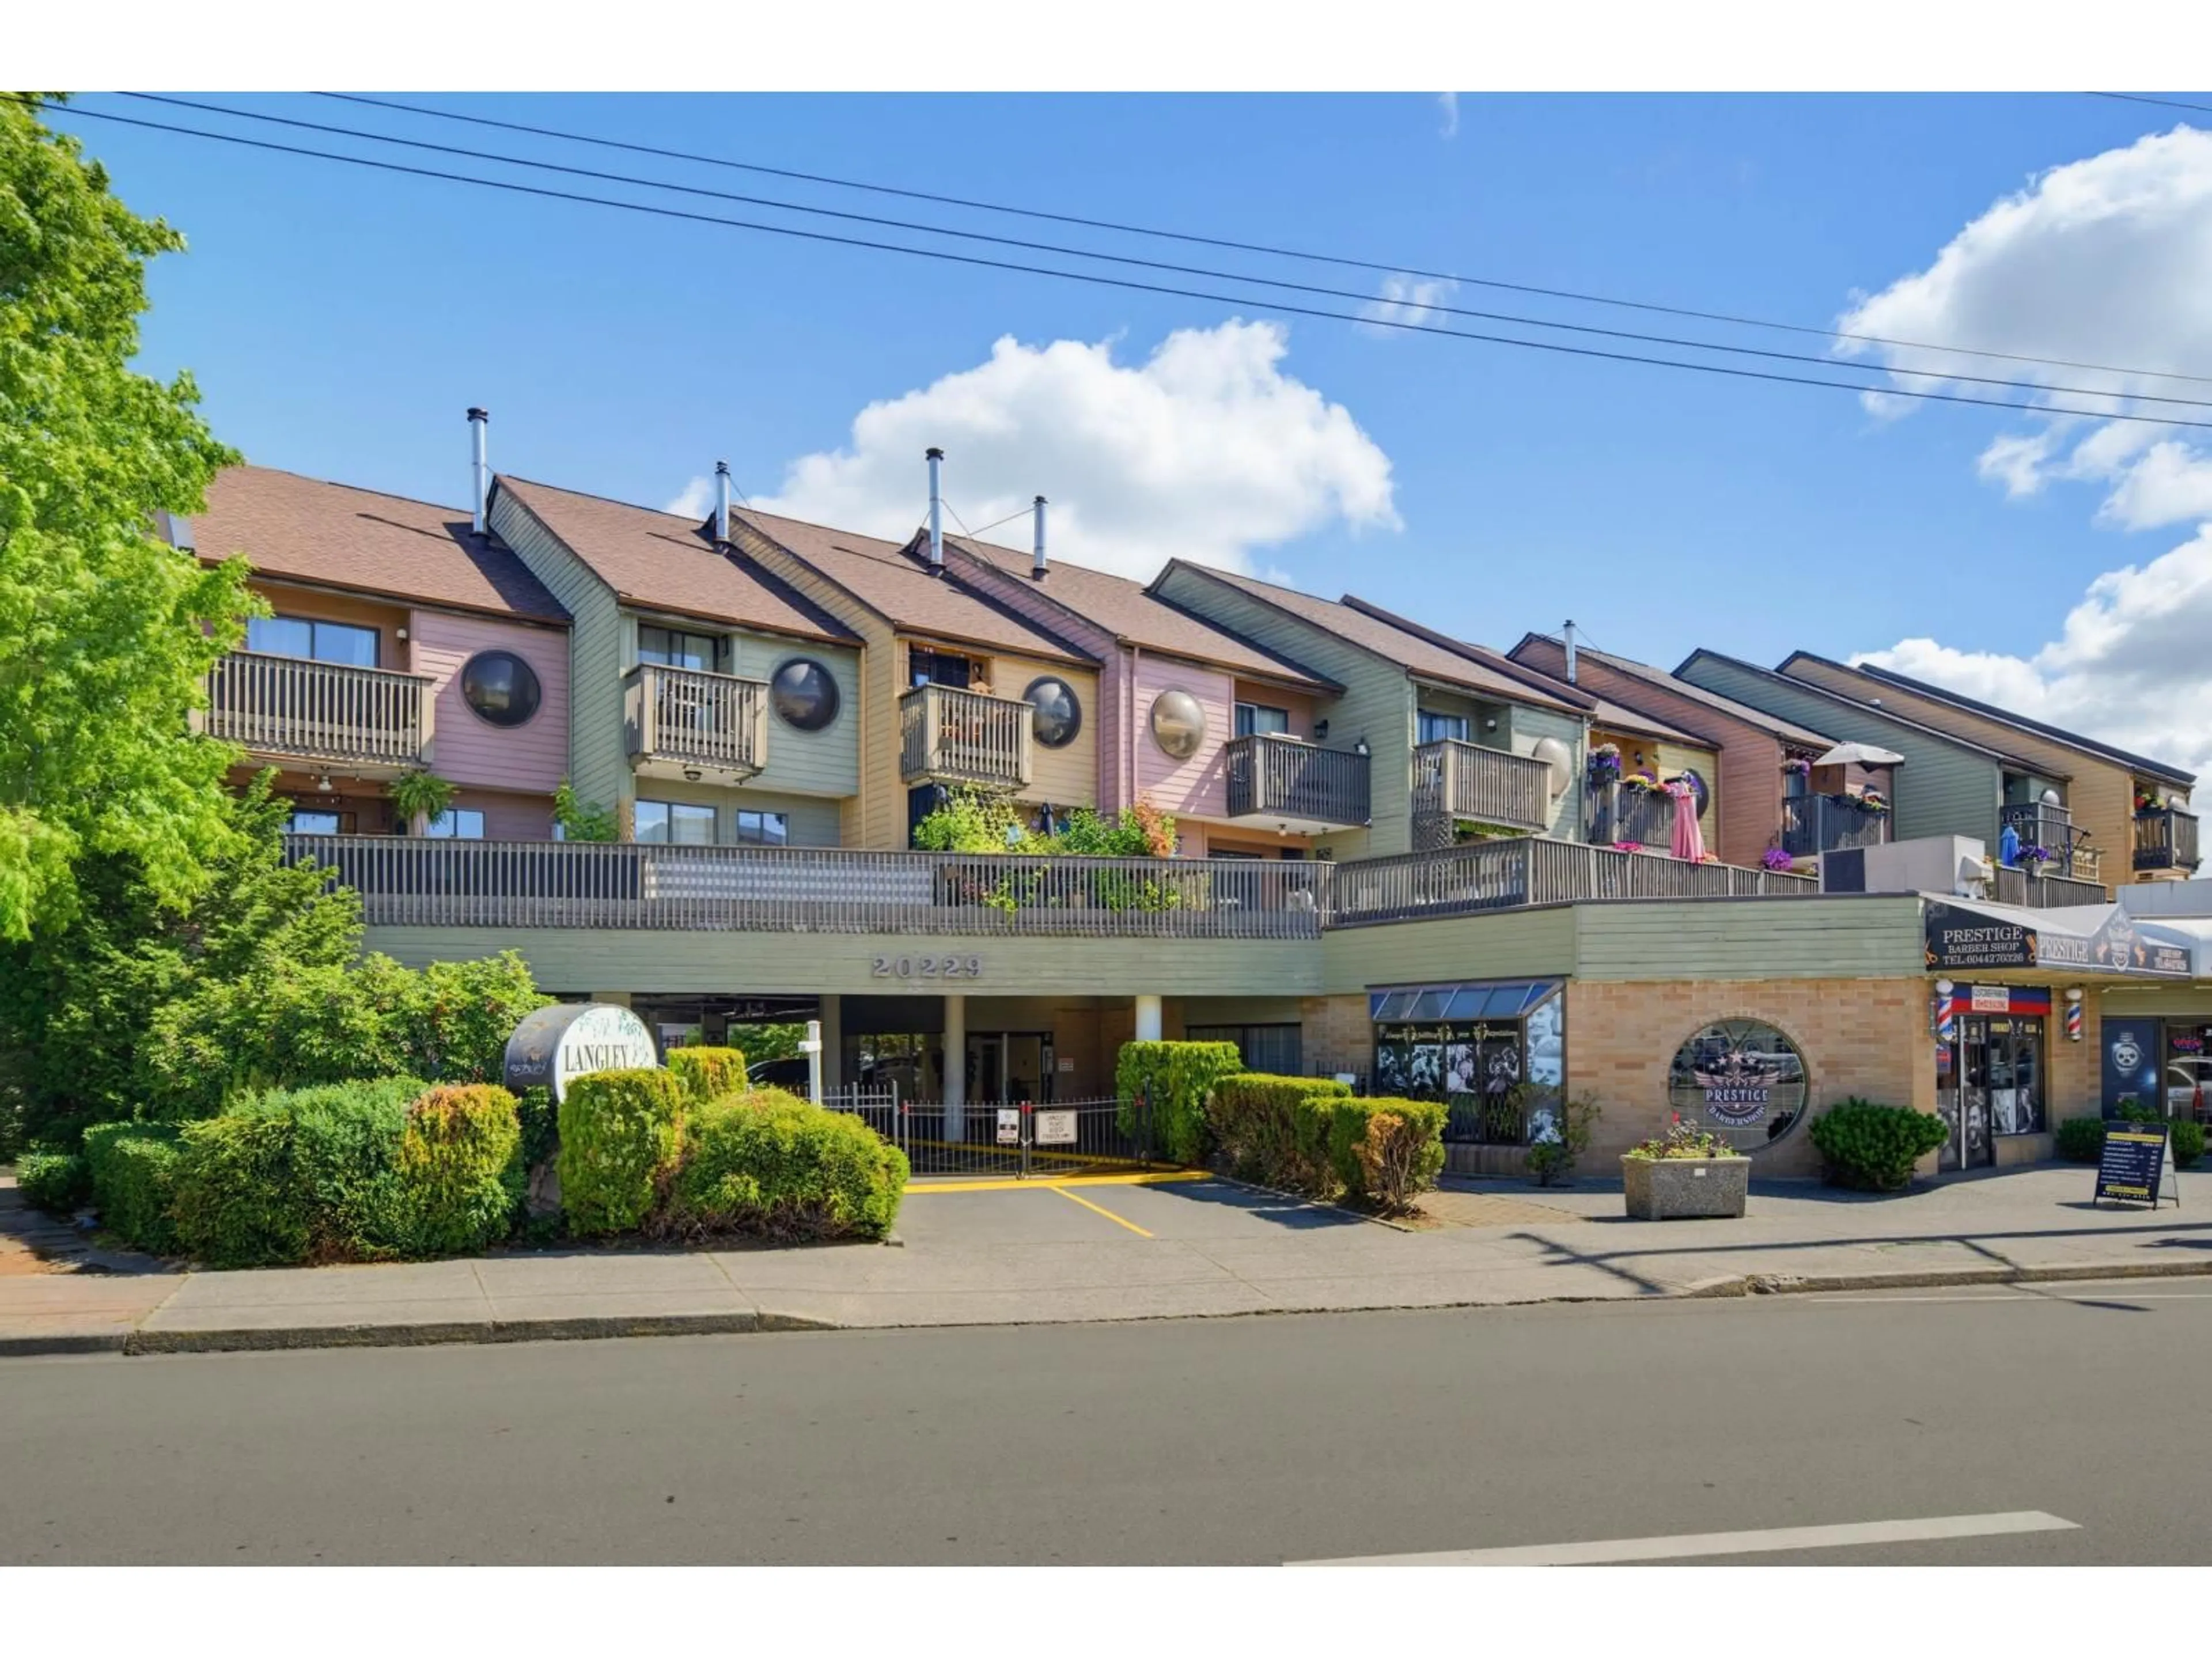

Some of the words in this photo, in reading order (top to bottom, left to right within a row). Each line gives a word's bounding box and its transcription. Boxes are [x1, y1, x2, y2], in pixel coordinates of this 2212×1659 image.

[1942, 926, 2022, 944] PRESTIGE
[1948, 944, 1988, 954] BARBER
[1990, 942, 2020, 952] SHOP
[2038, 937, 2089, 962] PRESTIGE
[872, 956, 982, 978] 20229
[565, 1044, 628, 1073] LANGLEY
